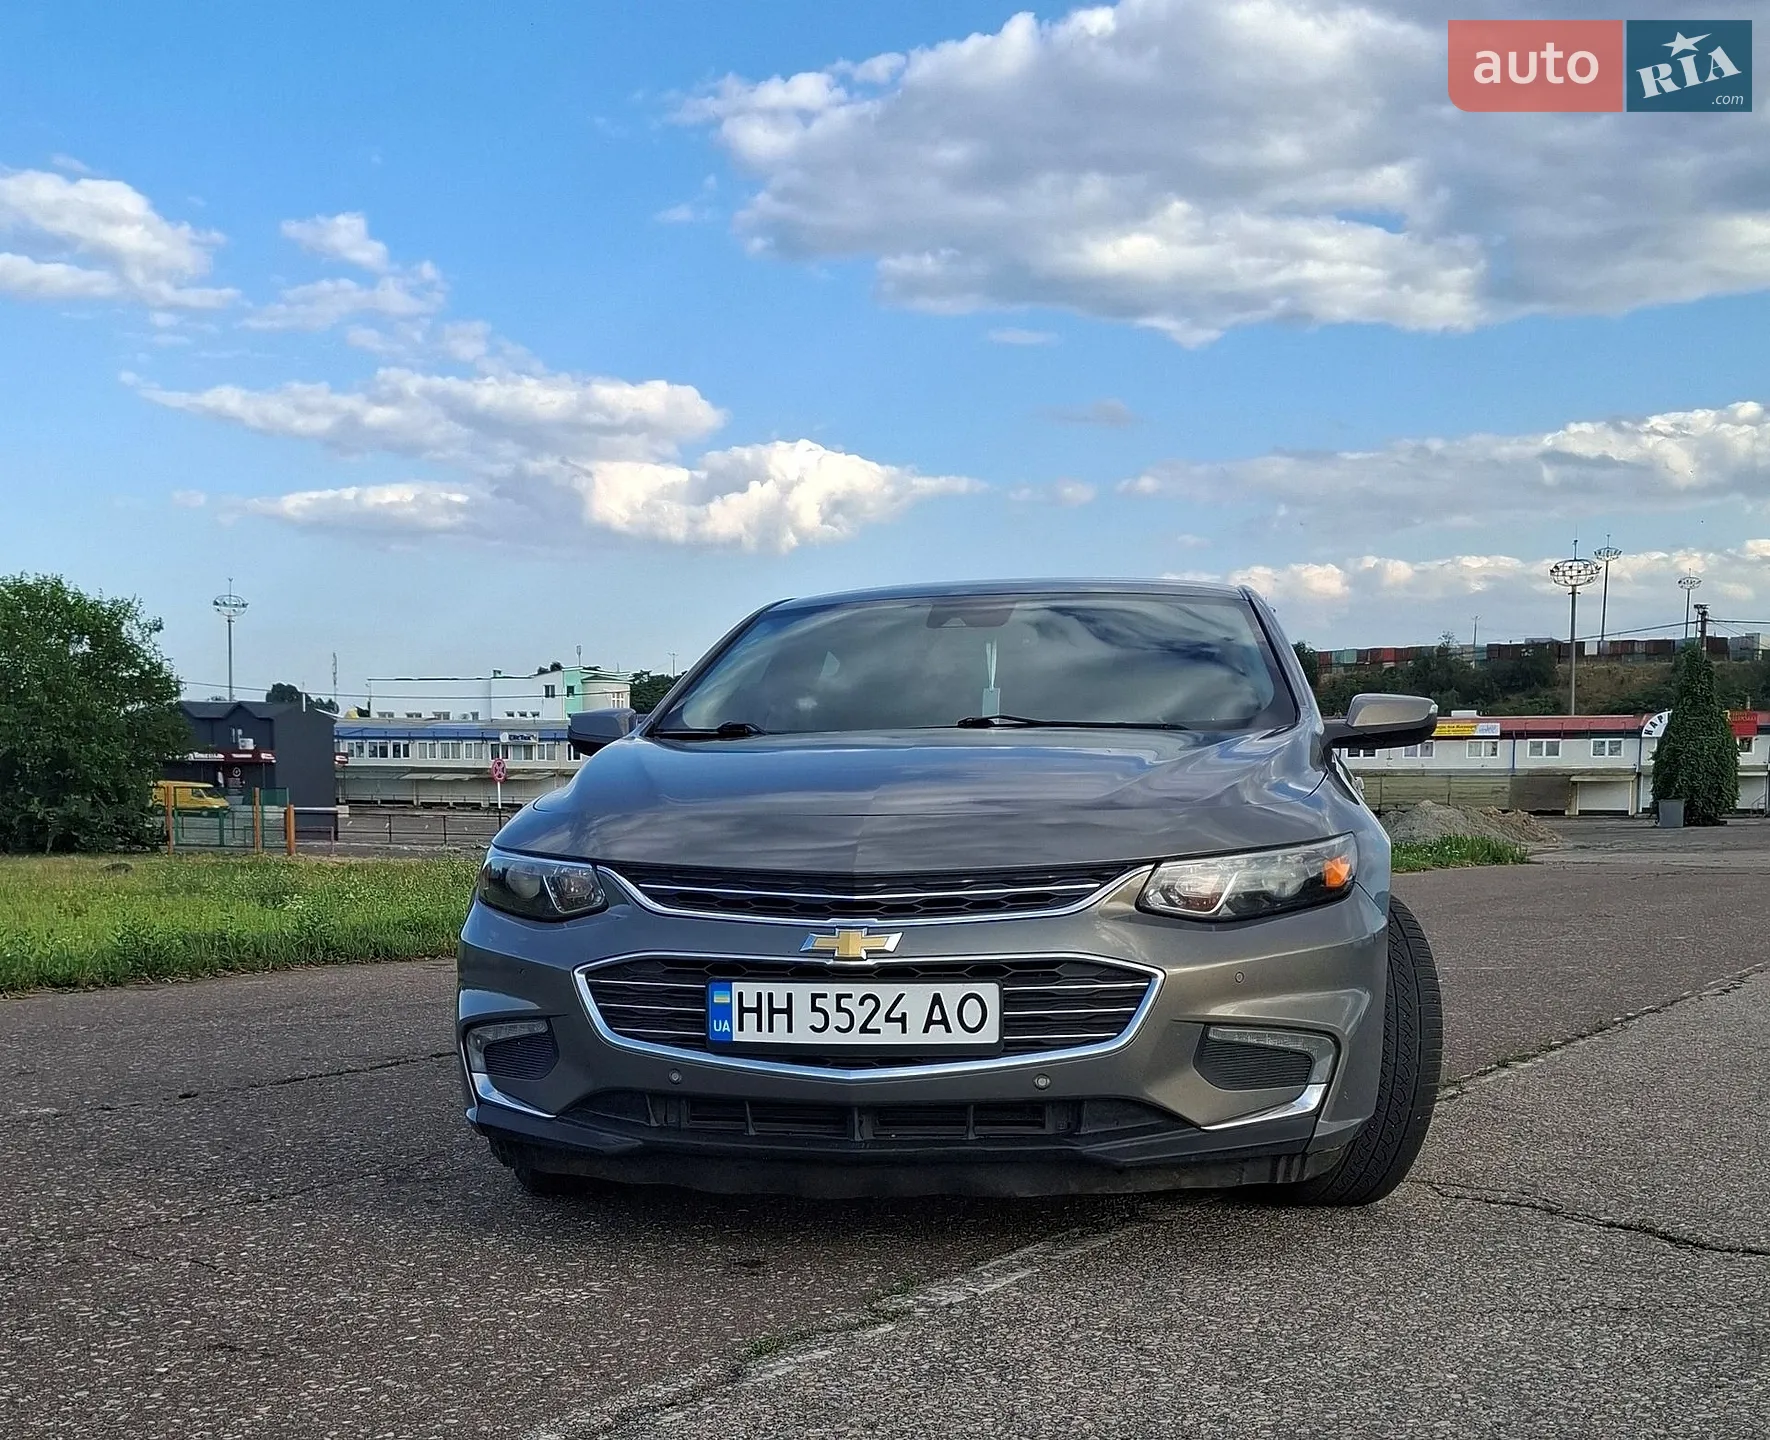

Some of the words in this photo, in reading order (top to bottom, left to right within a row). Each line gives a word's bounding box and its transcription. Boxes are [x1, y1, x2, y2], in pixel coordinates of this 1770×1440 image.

[713, 1019, 731, 1033] UA
[737, 991, 794, 1034] HH
[809, 992, 908, 1034] 5524
[922, 992, 988, 1034] AO
